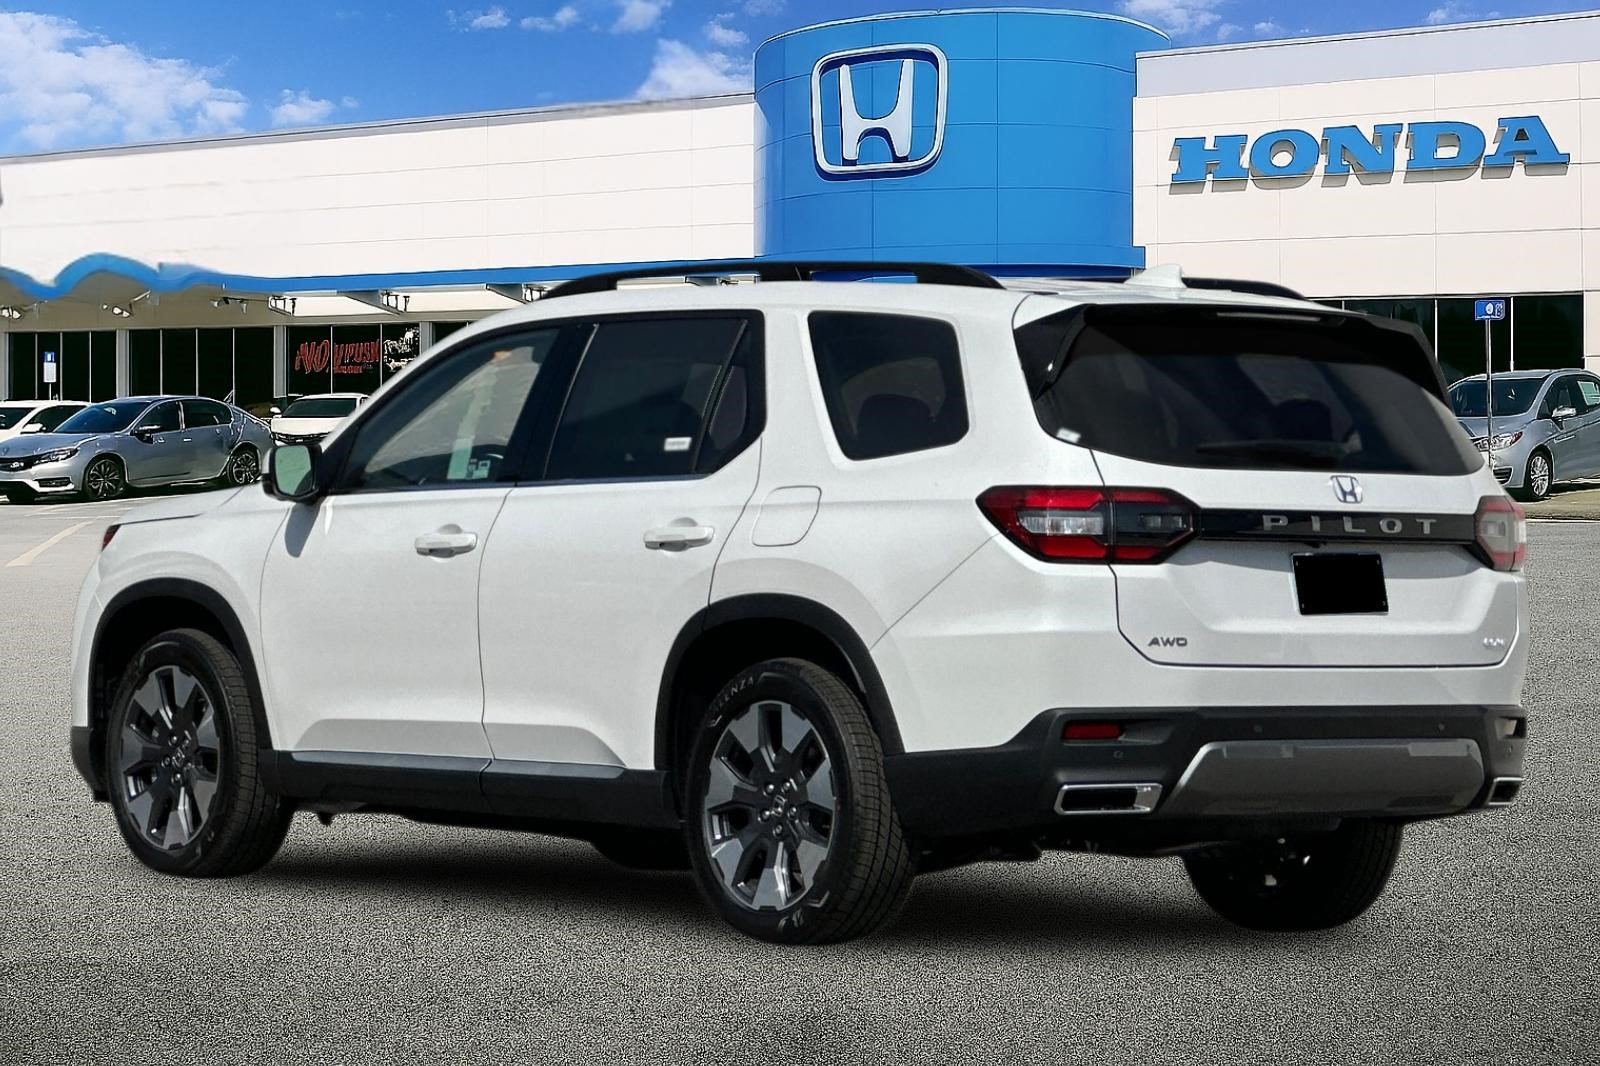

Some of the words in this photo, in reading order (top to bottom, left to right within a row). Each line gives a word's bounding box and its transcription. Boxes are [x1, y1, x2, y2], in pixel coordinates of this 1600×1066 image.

[1170, 115, 1570, 186] HONDA
[1262, 514, 1437, 535] PILOT
[1148, 637, 1188, 647] AWD
